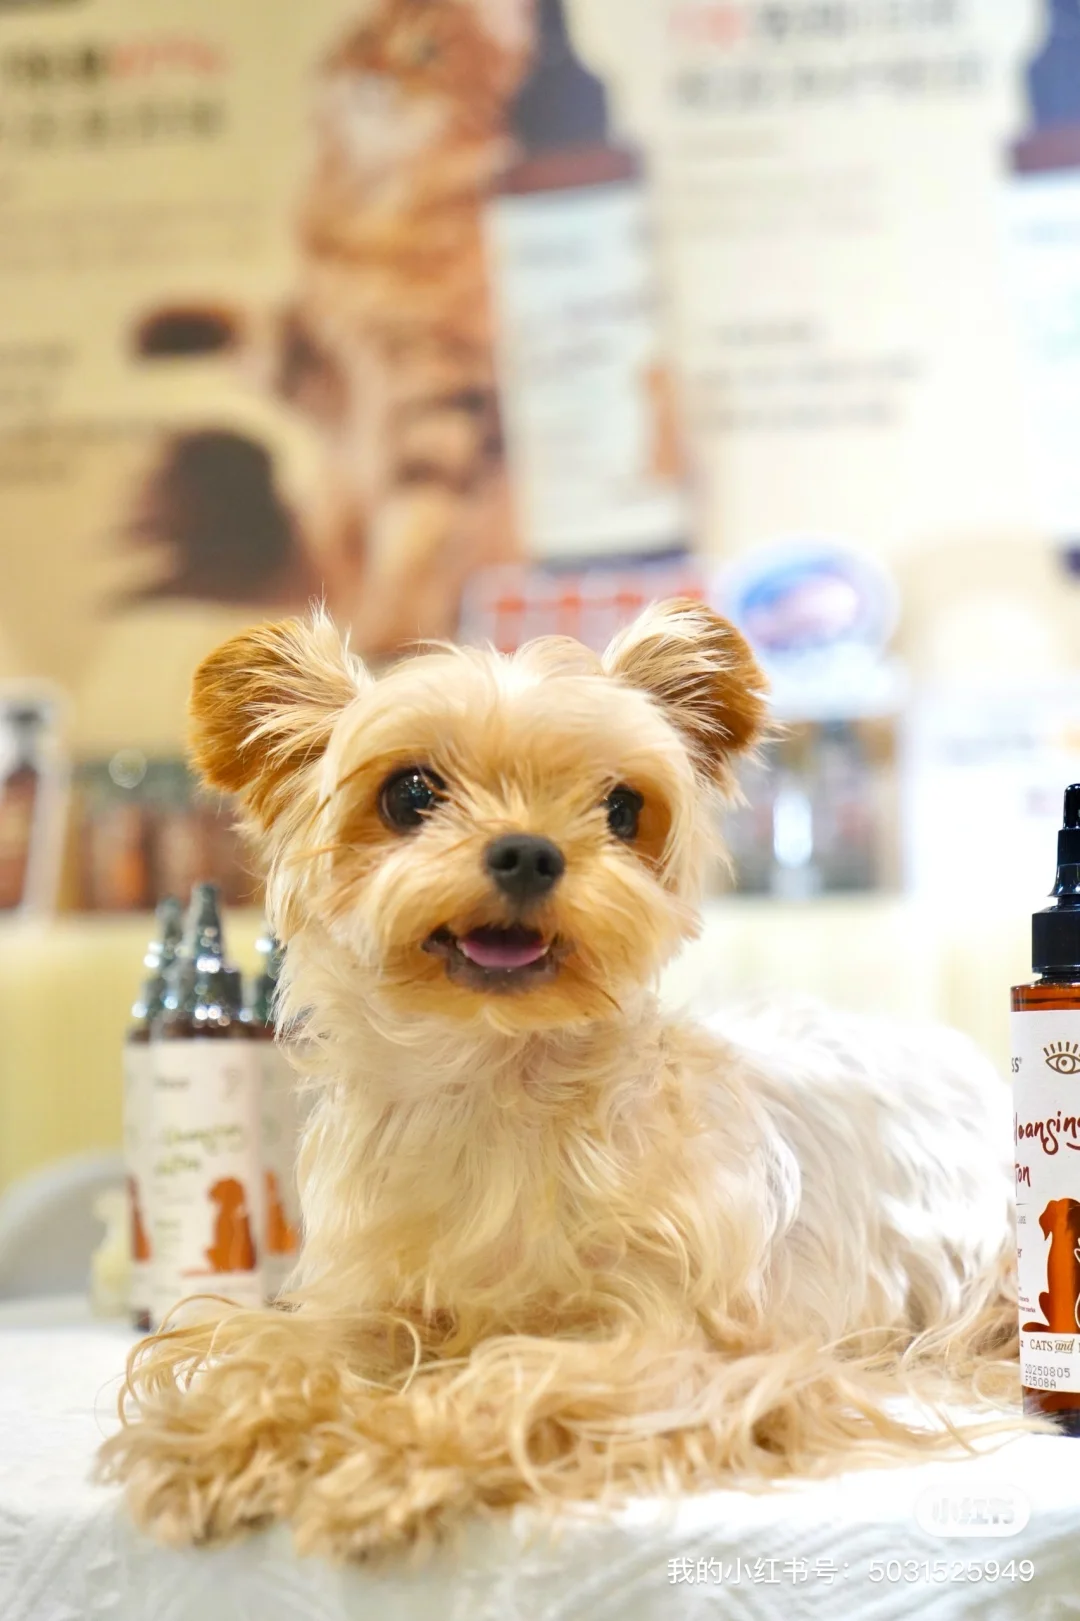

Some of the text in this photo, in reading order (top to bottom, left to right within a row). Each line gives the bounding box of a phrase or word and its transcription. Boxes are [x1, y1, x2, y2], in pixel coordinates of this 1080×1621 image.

[1030, 1339, 1053, 1352] CATS
[1055, 1338, 1075, 1354] and
[1025, 1363, 1071, 1378] 20250805
